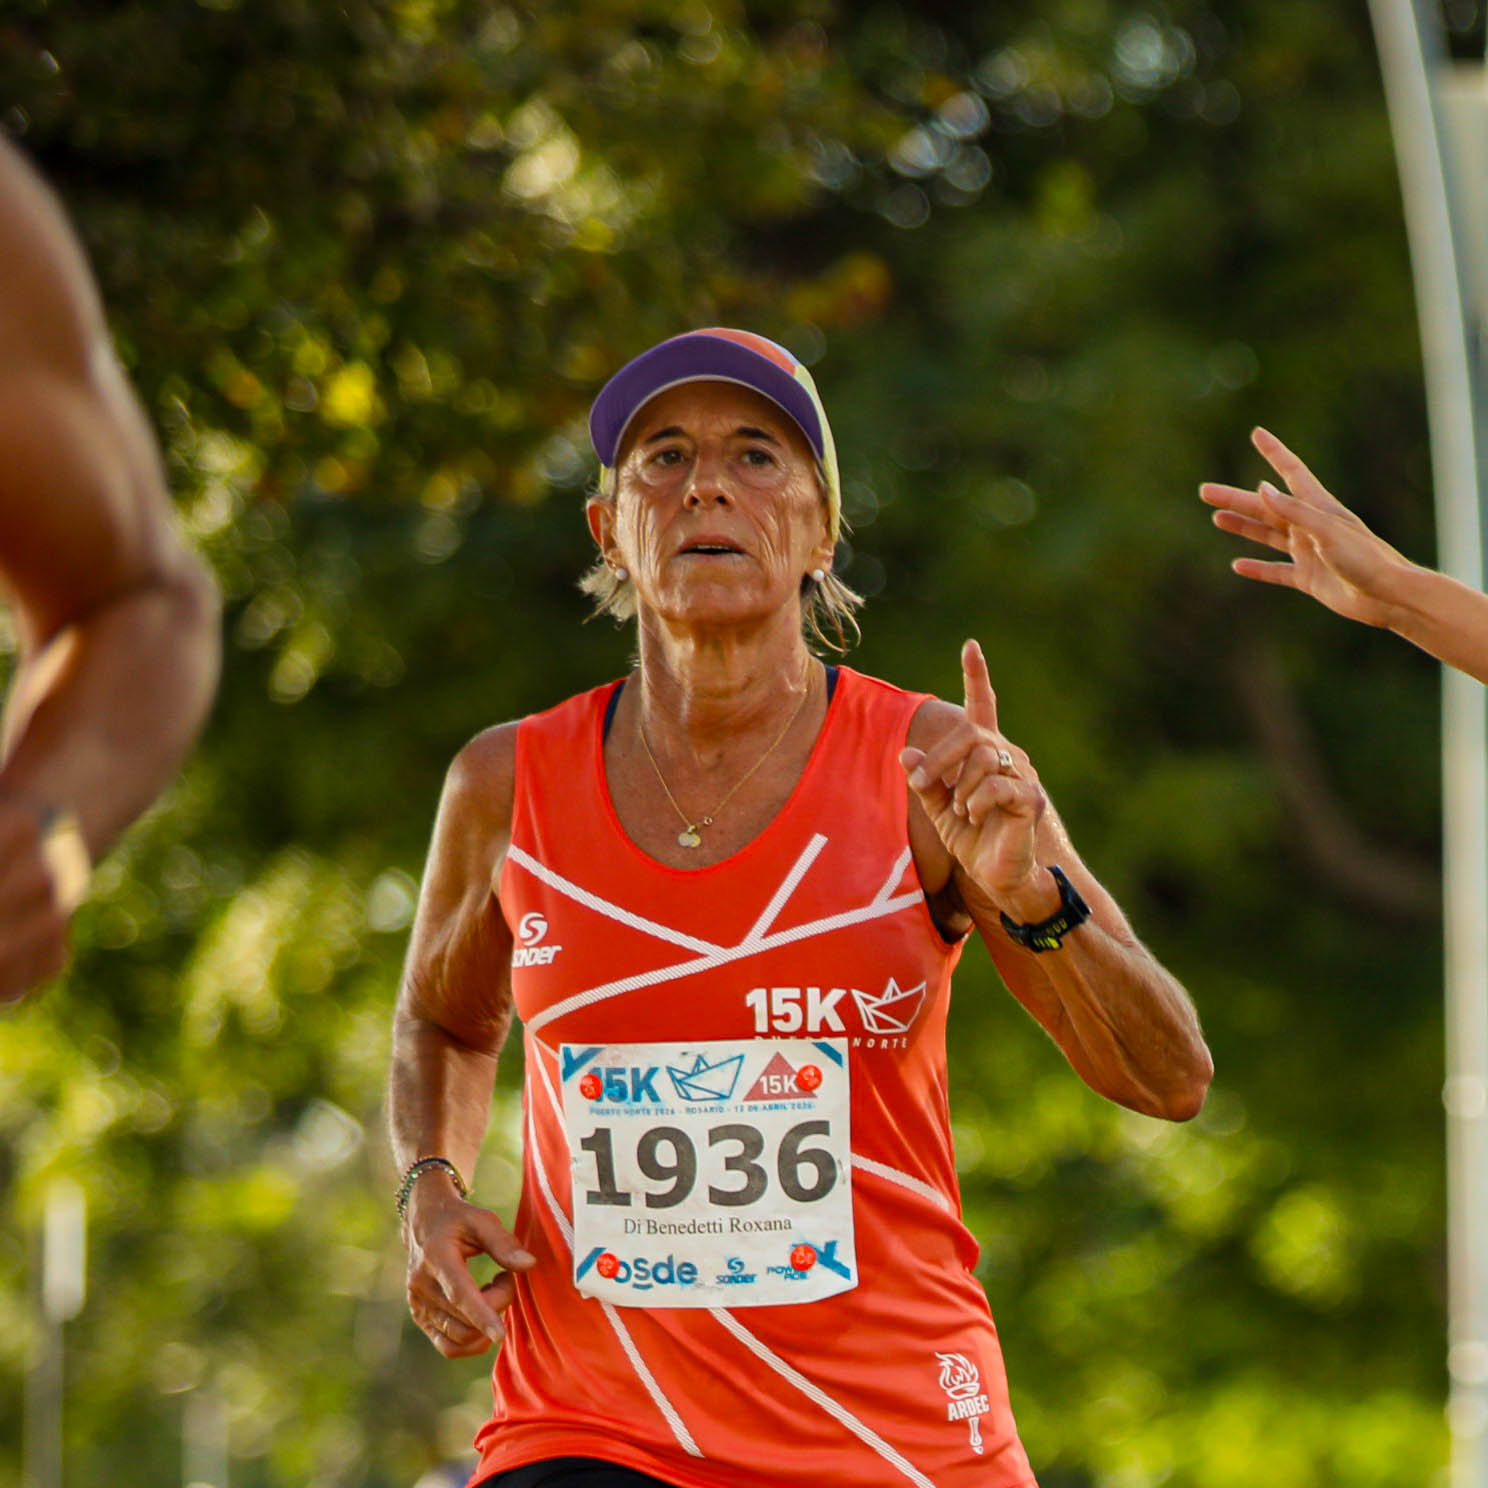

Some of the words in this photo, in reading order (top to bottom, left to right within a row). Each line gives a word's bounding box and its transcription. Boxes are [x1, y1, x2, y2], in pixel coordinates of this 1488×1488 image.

[746, 987, 847, 1033] 15K
[852, 1037, 908, 1049] NORTE
[760, 1074, 799, 1094] 15K
[580, 1120, 838, 1208] 1936
[624, 1217, 642, 1235] Di
[646, 1217, 724, 1235] Benedetti
[728, 1216, 793, 1233] Roxana
[948, 1394, 990, 1421] ARDEC
